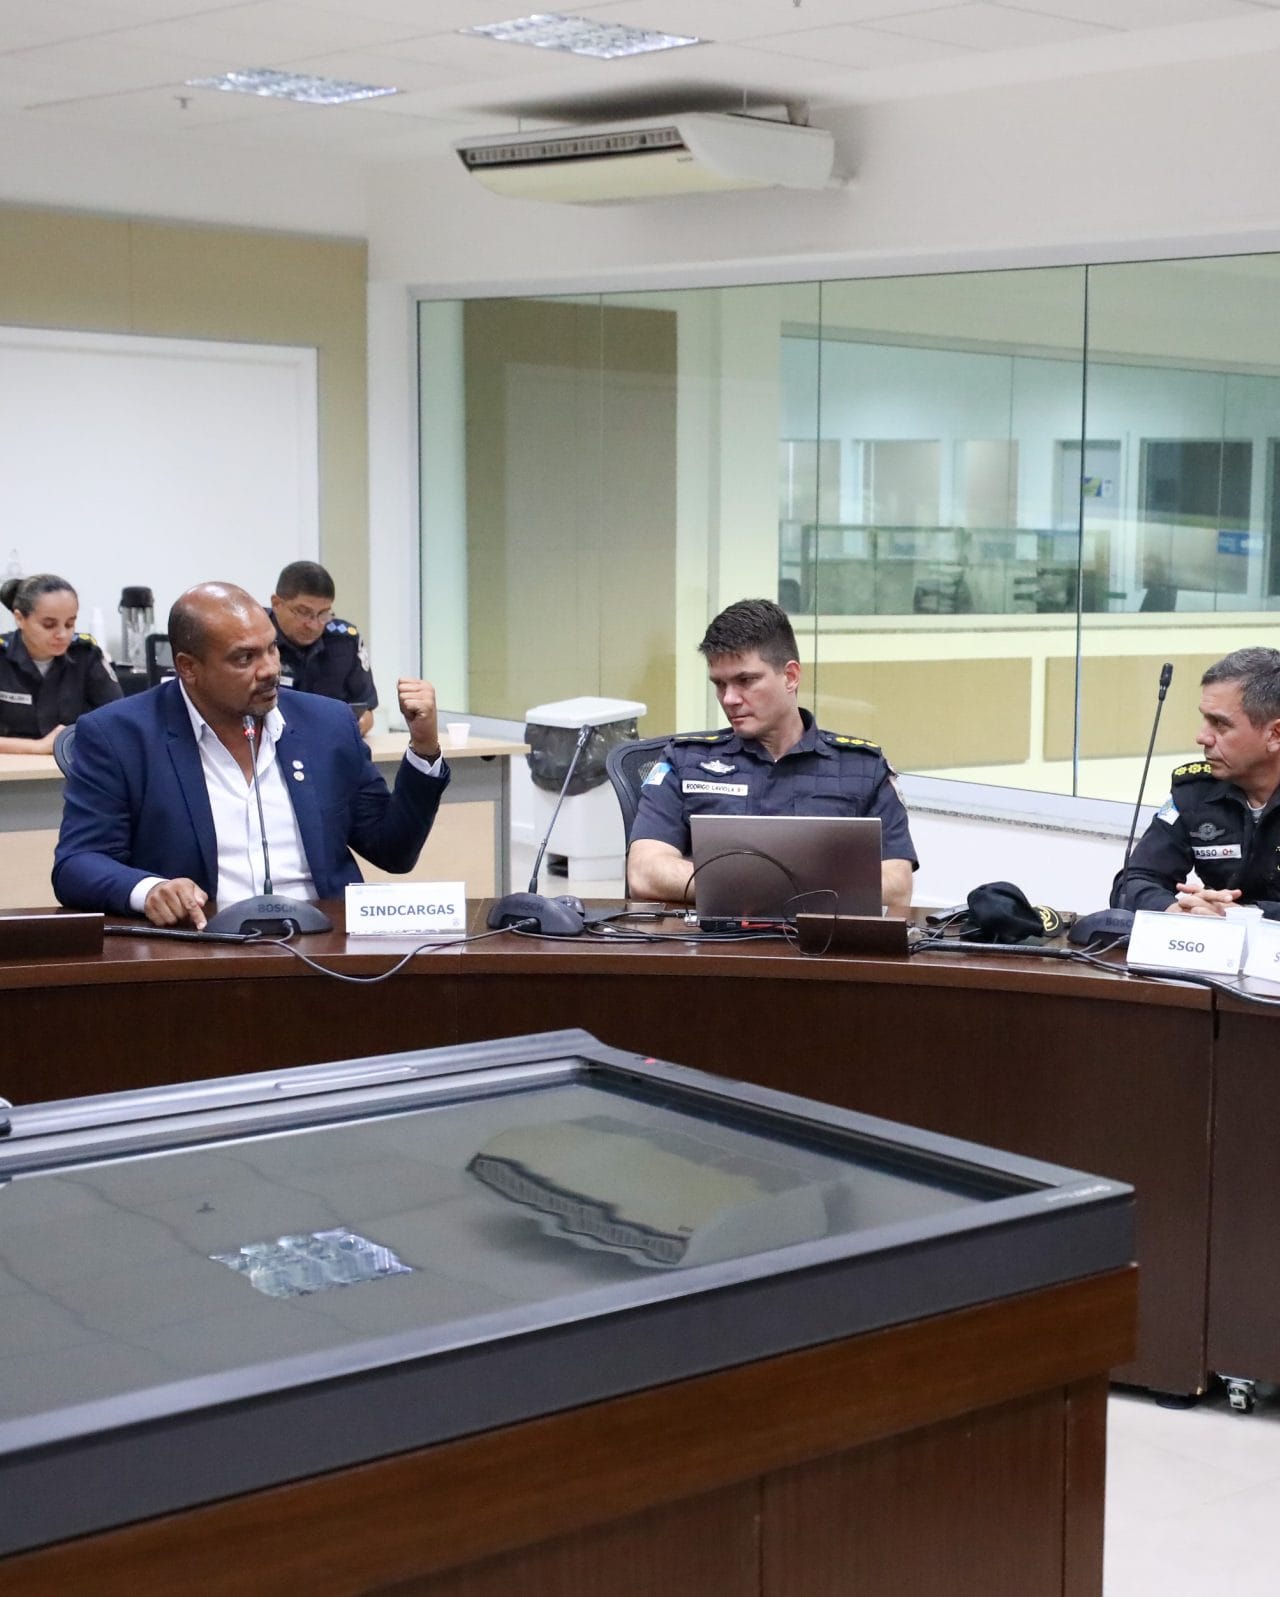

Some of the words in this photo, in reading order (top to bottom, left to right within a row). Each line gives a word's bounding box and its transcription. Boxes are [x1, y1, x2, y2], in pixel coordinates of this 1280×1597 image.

[257, 903, 297, 913] BOSCH
[360, 903, 455, 917] SINDCARGAS
[1105, 917, 1132, 928] BOSC
[1168, 939, 1206, 954] SSGO
